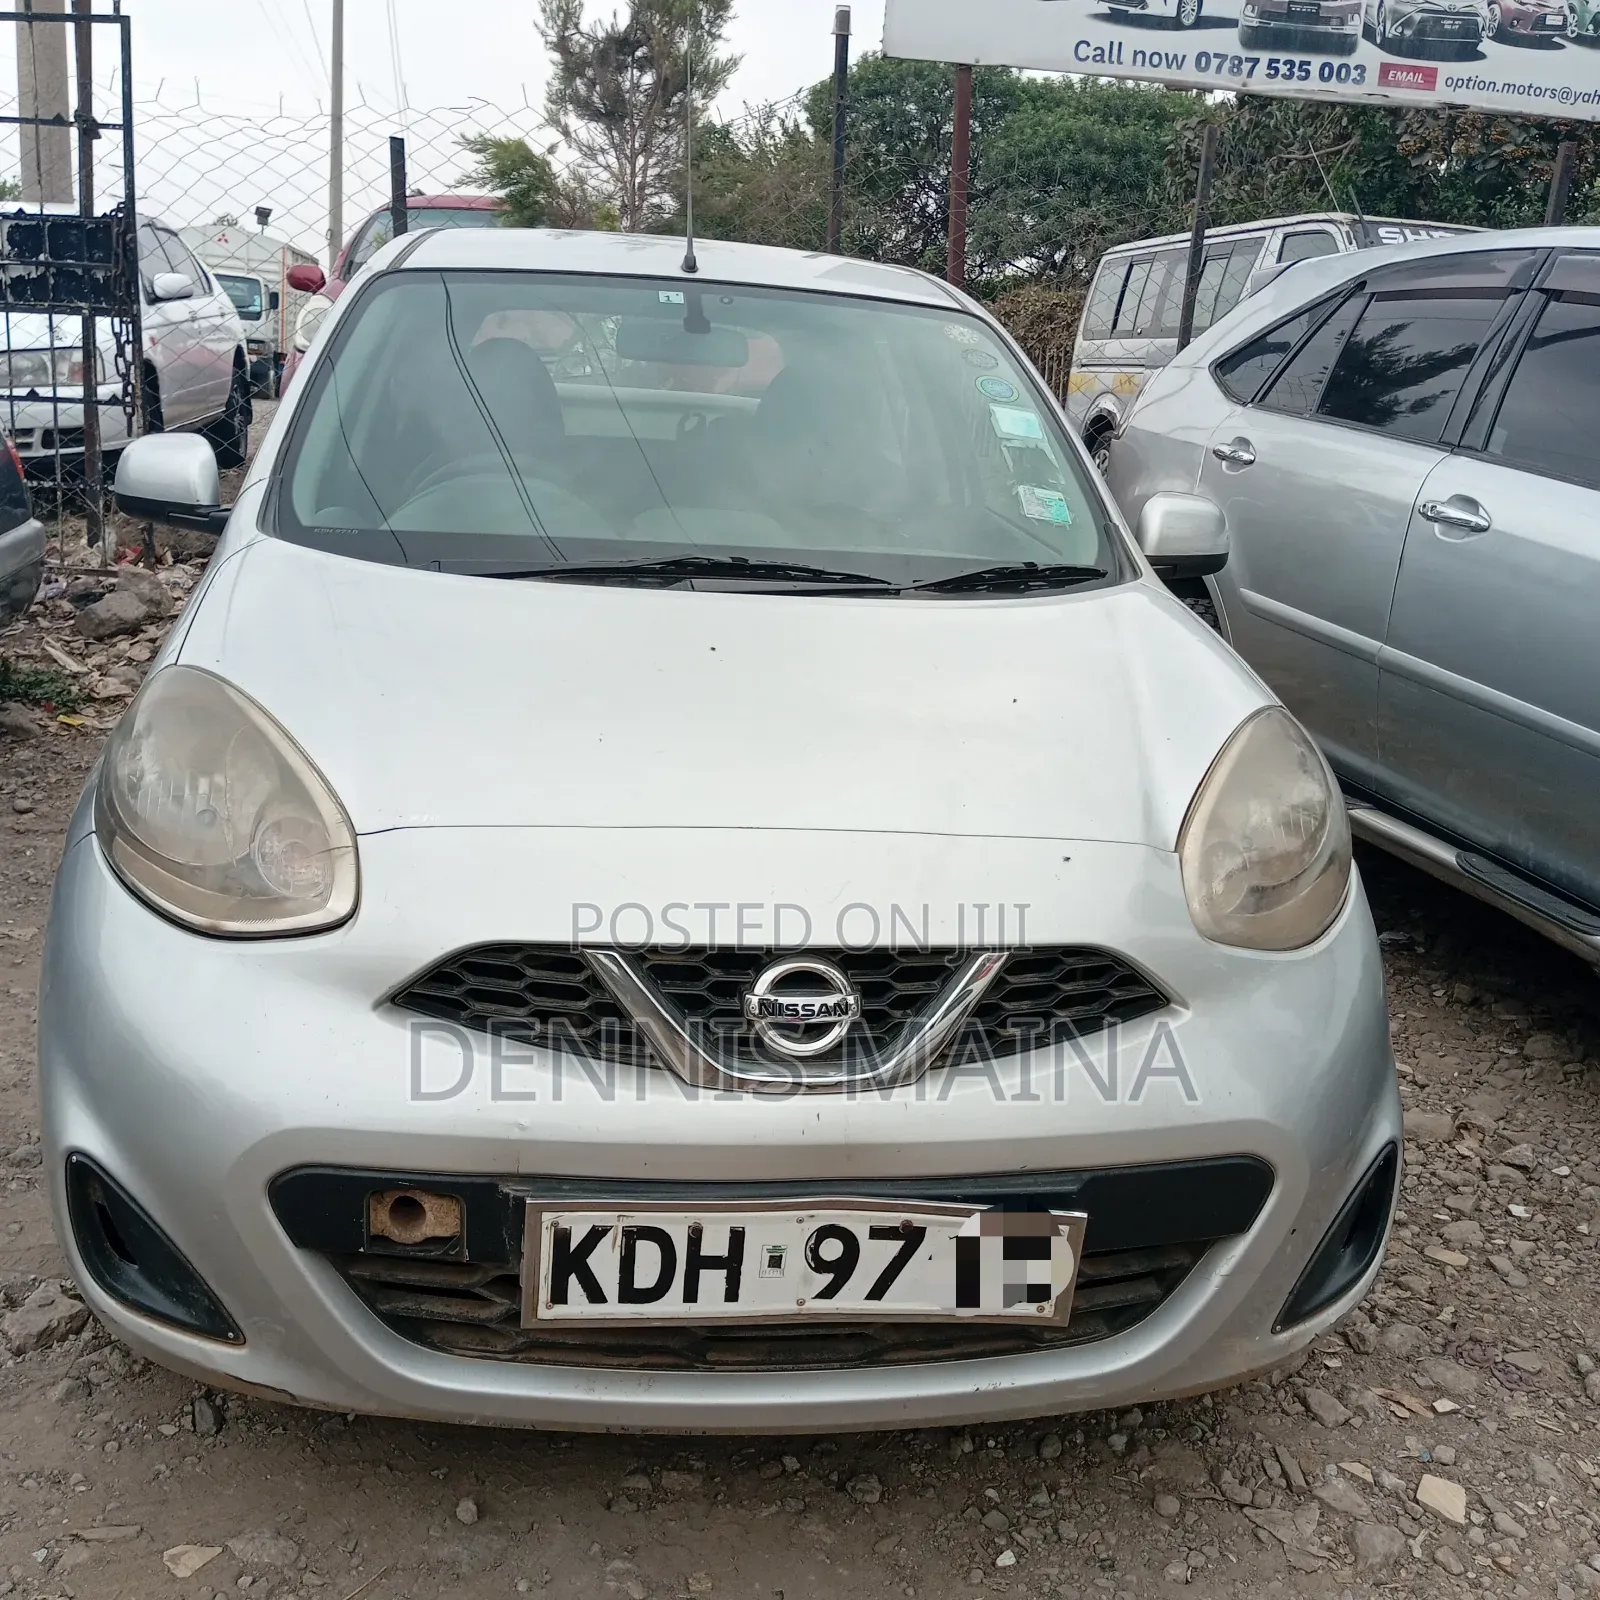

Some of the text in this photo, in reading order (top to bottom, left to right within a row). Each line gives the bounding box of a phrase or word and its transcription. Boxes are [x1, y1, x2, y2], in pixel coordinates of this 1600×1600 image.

[1074, 40, 1367, 85] Call now 0787 535 003
[1388, 70, 1425, 84] EMAIL
[758, 998, 849, 1018] NISSAN
[547, 1225, 745, 1305] KDH
